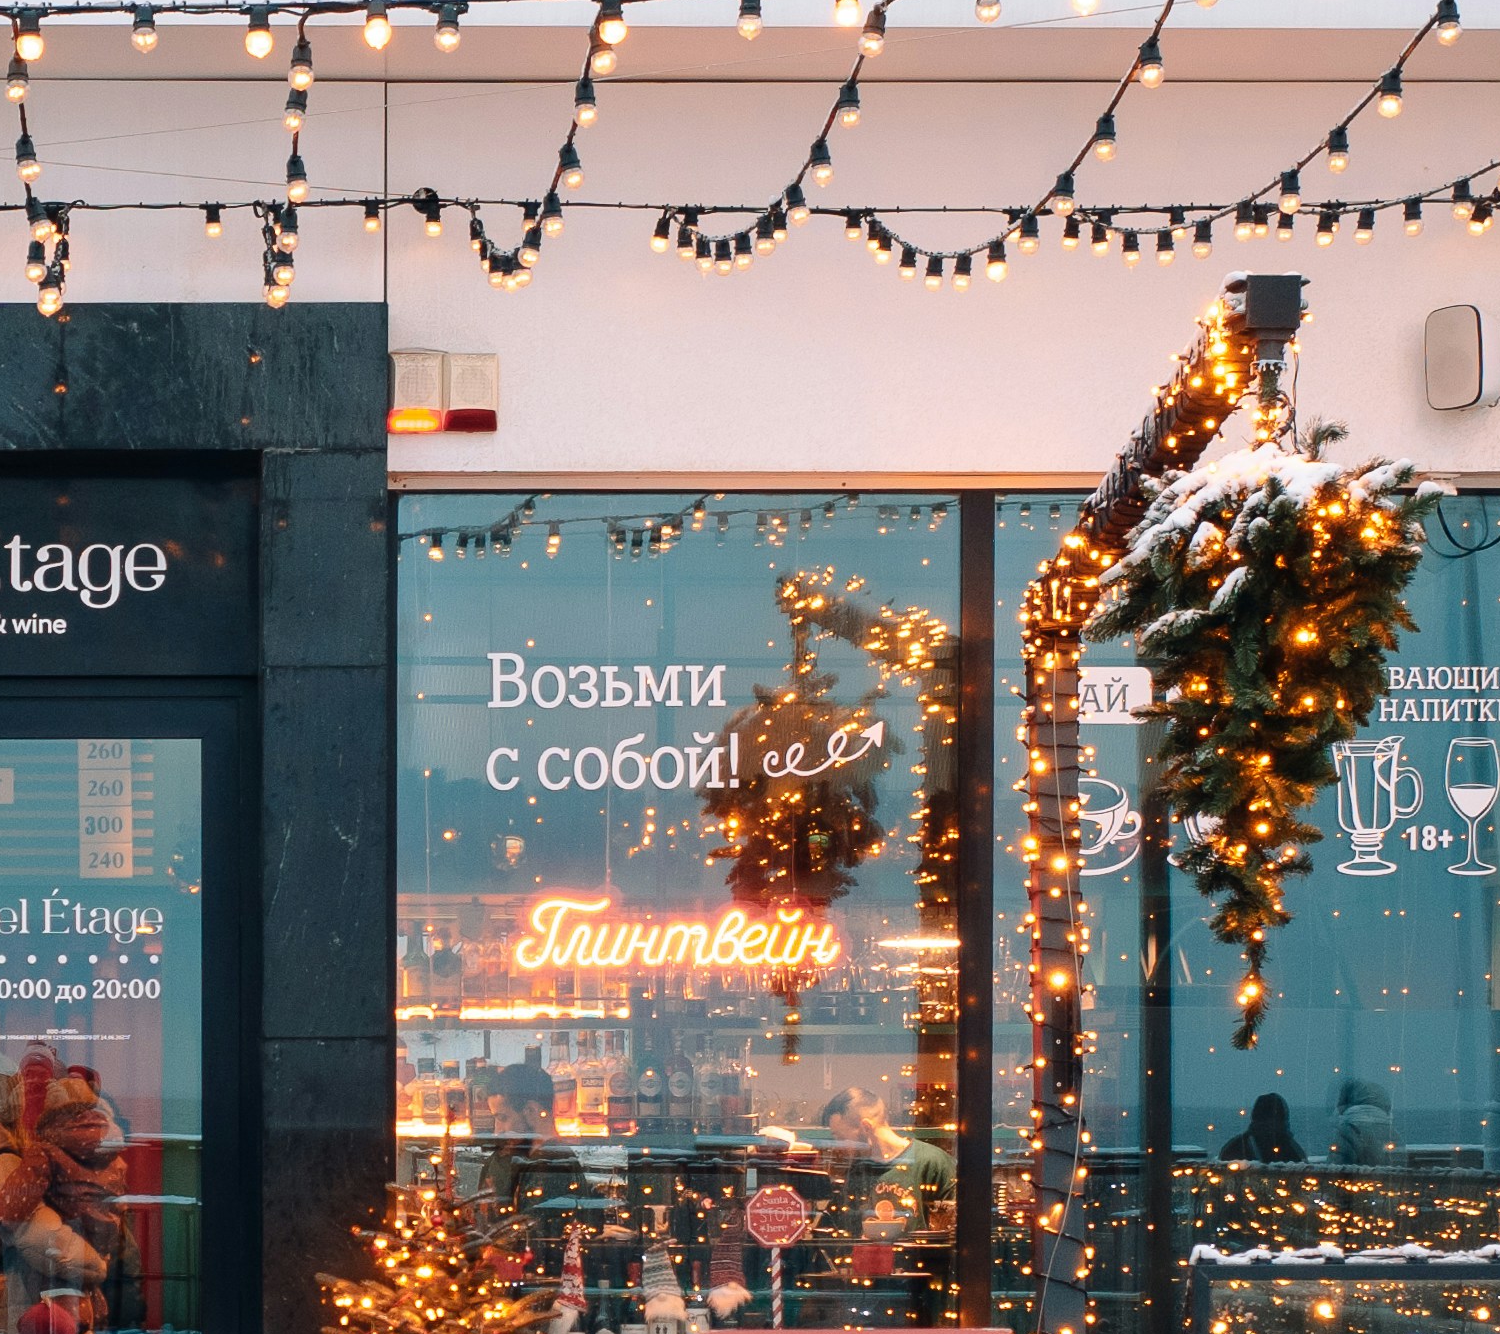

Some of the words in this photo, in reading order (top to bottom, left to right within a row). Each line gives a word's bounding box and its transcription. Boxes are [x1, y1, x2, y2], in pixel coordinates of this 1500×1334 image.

[12, 613, 67, 636] wine
[486, 652, 726, 709] Возьми
[1080, 677, 1130, 714] АЙ
[86, 741, 123, 760] 260
[485, 746, 519, 791] с
[538, 731, 740, 791] собой!
[87, 779, 124, 798] 260
[84, 815, 123, 836] 300
[1405, 826, 1453, 851] 18+
[88, 851, 124, 869] 240
[42, 888, 164, 944] Étage
[516, 896, 842, 972] Глинтвейн
[54, 984, 87, 1004] до
[92, 979, 161, 1000] 20:00
[762, 1196, 789, 1205] Santa
[759, 1207, 793, 1223] STOP
